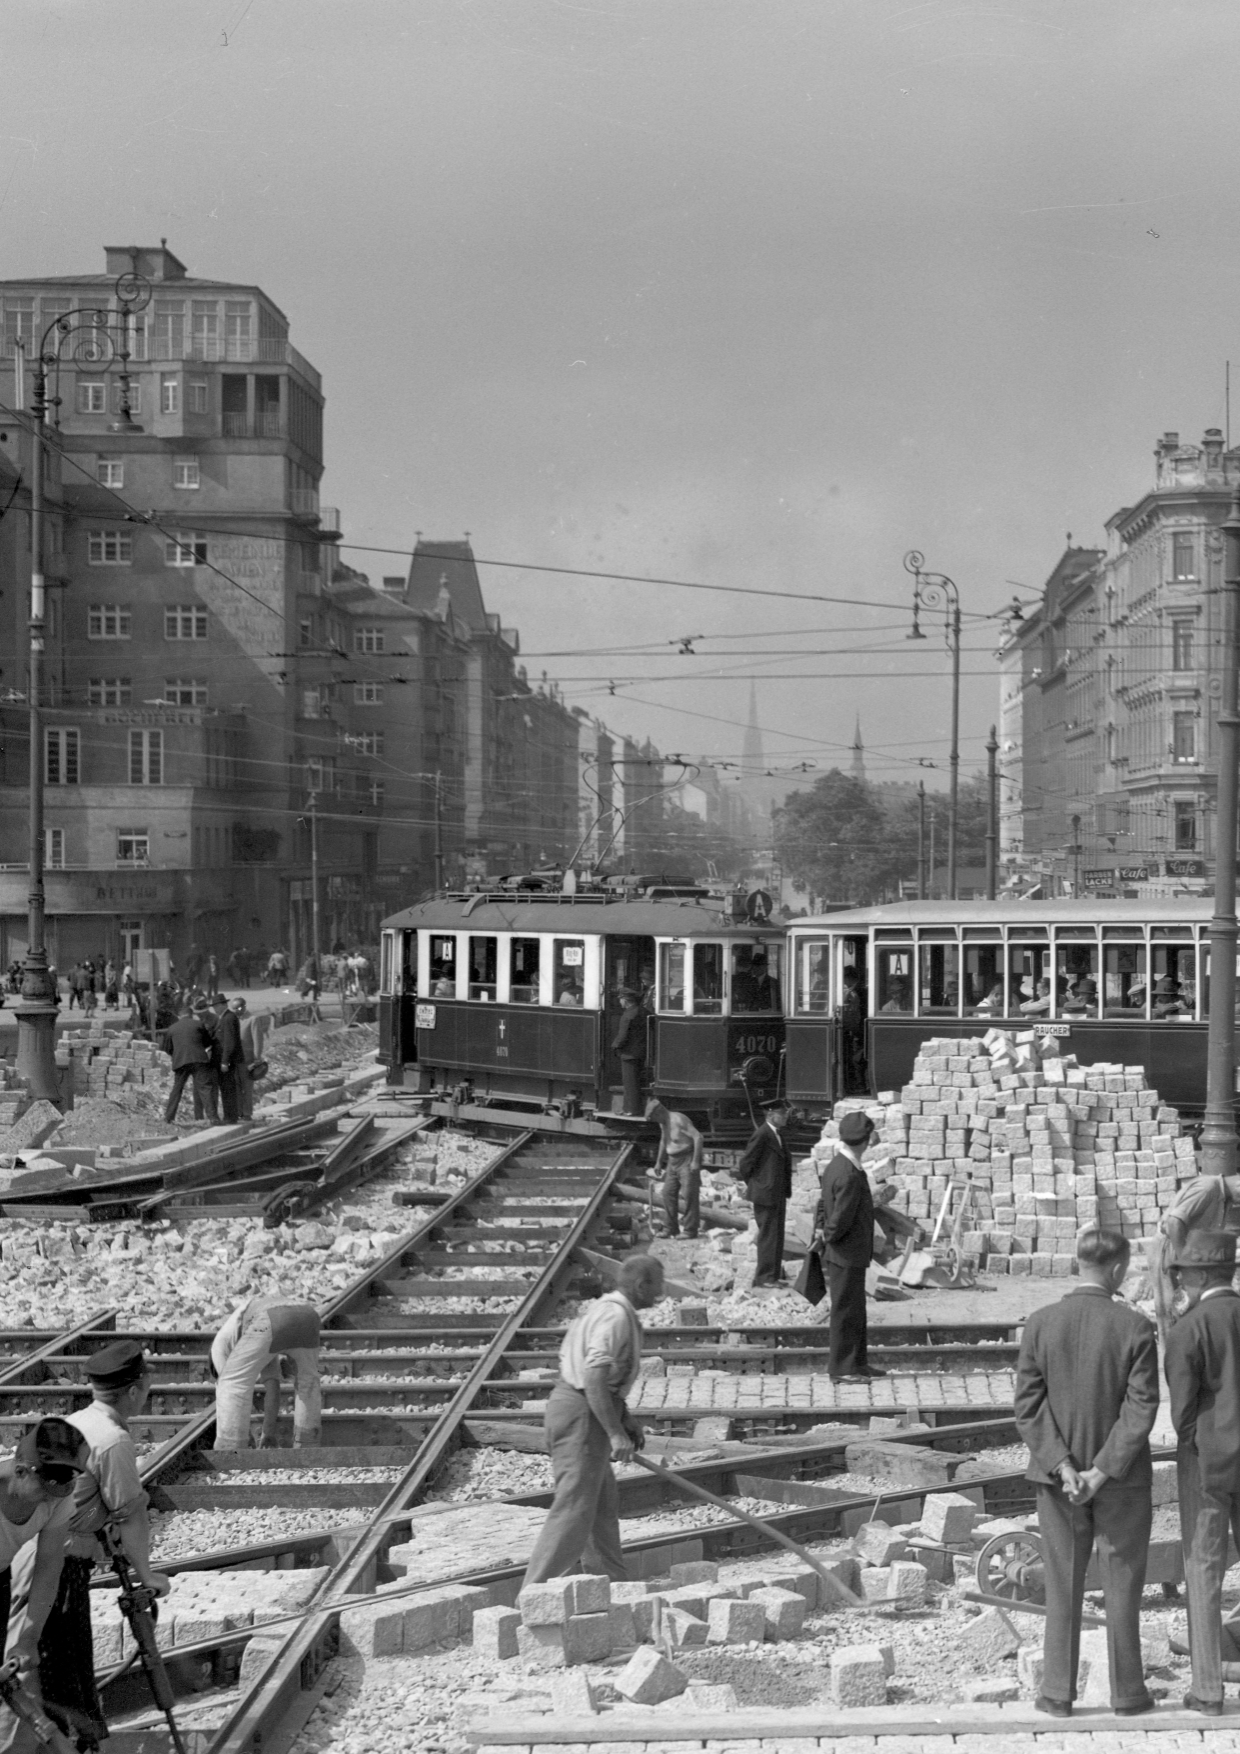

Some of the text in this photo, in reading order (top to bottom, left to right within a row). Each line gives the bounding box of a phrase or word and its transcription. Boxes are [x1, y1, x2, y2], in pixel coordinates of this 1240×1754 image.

[755, 894, 767, 917] A
[895, 954, 903, 974] A
[1036, 1026, 1068, 1036] RAUCHER
[735, 1035, 777, 1053] 4070
